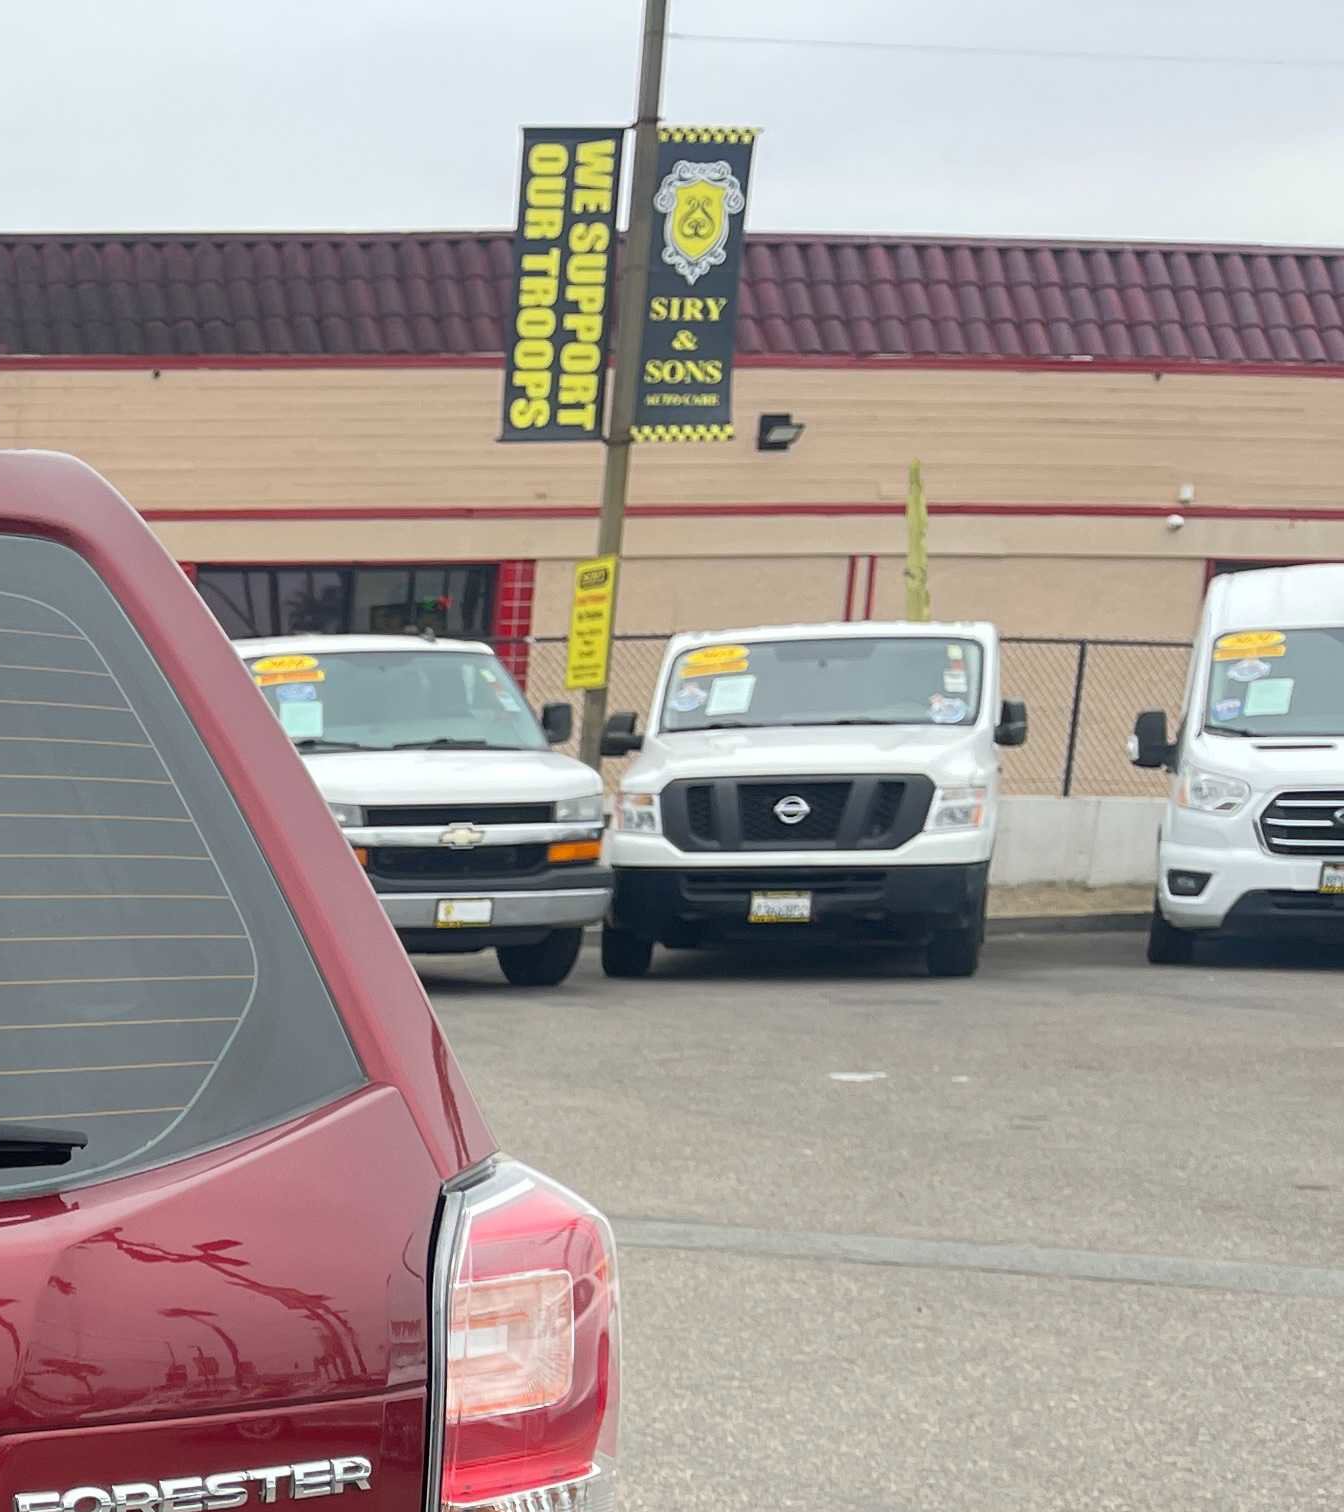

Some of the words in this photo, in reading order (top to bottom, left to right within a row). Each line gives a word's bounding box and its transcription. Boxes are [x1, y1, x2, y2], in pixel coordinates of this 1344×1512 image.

[523, 143, 569, 241] OUR
[572, 138, 616, 214] WE
[510, 247, 560, 429] TROOPS
[557, 222, 610, 431] SUPPORT
[649, 297, 728, 321] SIRY
[671, 330, 698, 351] &
[644, 360, 722, 384] SONS
